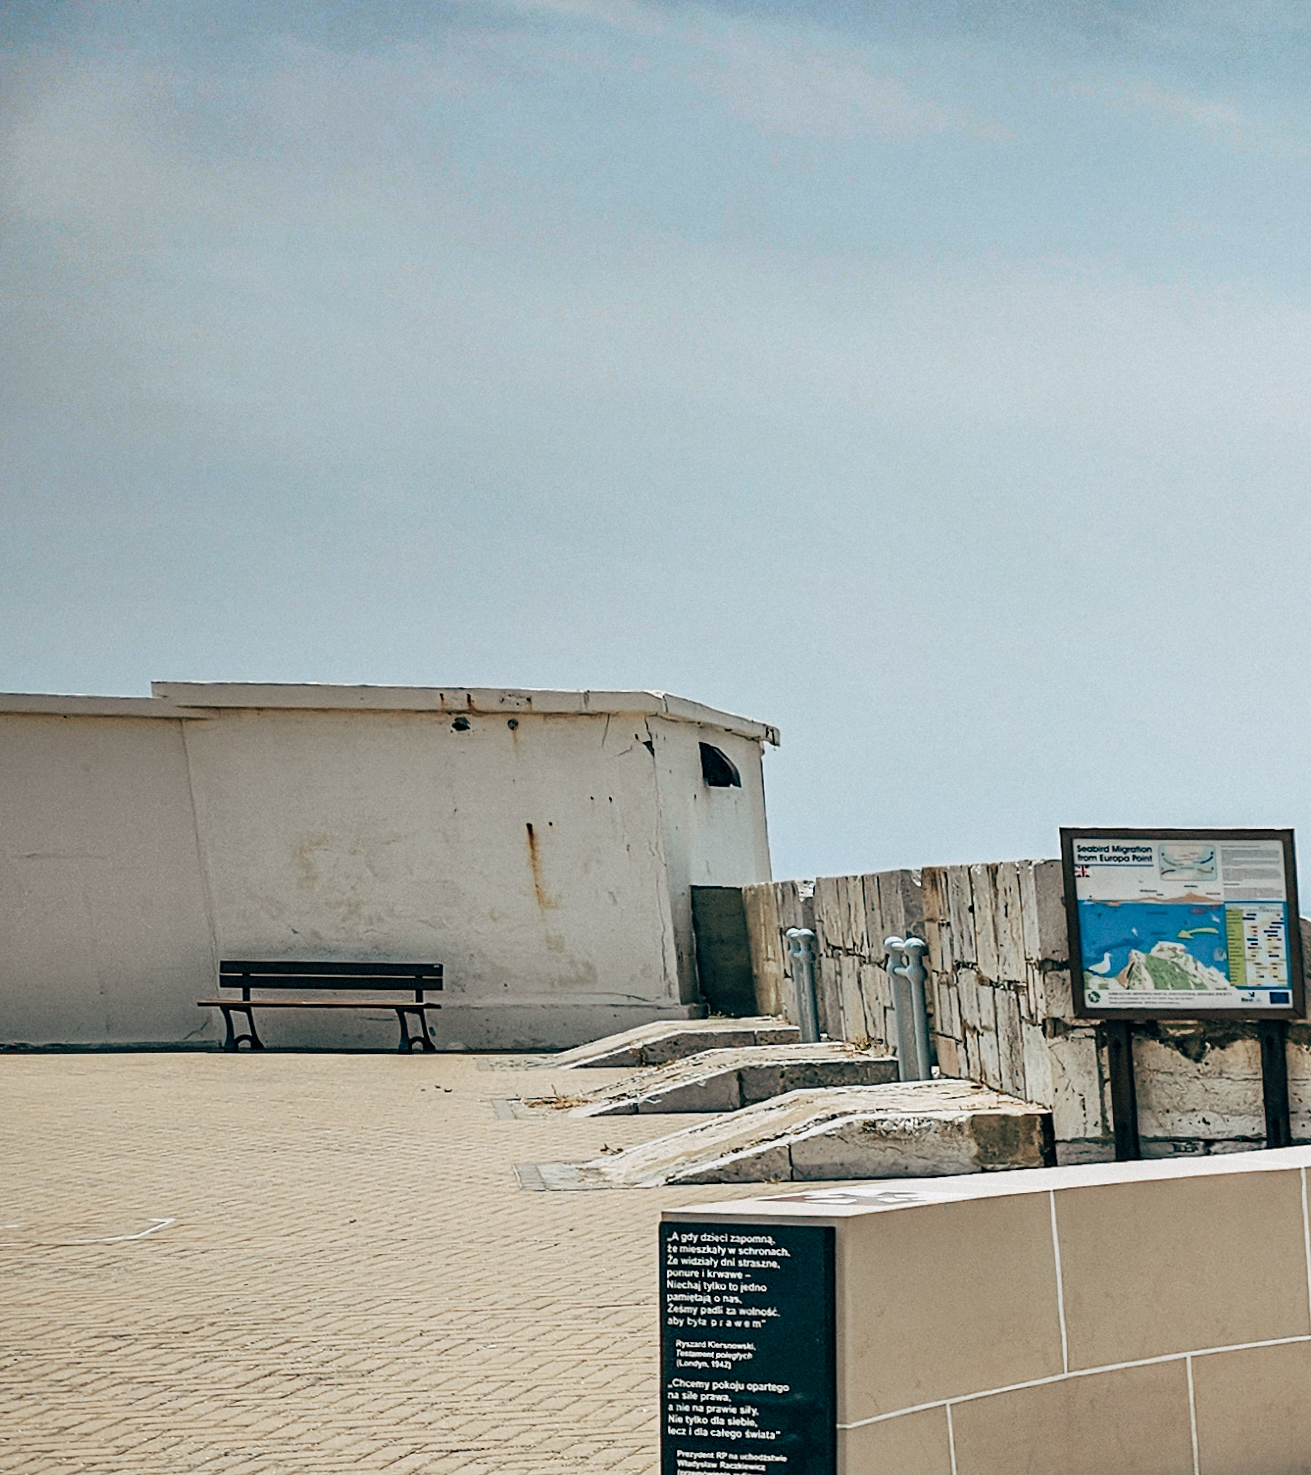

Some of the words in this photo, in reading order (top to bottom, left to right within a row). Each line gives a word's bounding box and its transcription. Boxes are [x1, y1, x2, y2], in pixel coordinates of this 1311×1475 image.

[1077, 845, 1109, 853] Seabird
[1112, 845, 1152, 854] Migration
[1077, 854, 1097, 862] from
[1100, 854, 1130, 863] Europa
[1132, 854, 1152, 862] Point
